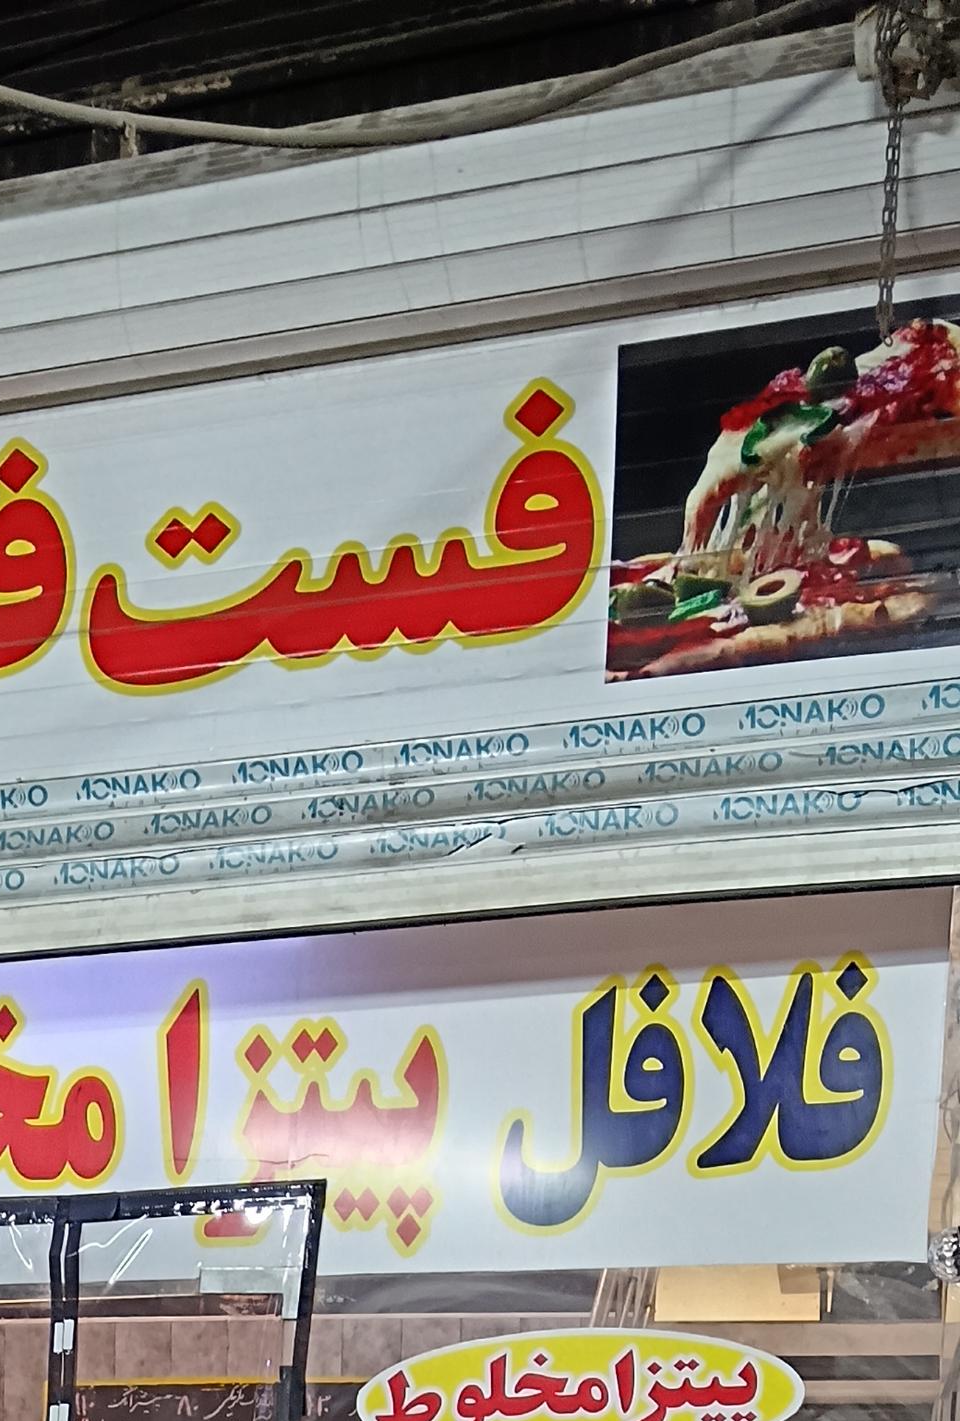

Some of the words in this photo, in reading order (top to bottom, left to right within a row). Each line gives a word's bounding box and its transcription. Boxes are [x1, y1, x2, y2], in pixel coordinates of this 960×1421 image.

[83, 378, 603, 695] فست
[161, 979, 447, 1253] پیتزا
[495, 953, 892, 1234] فلافل
